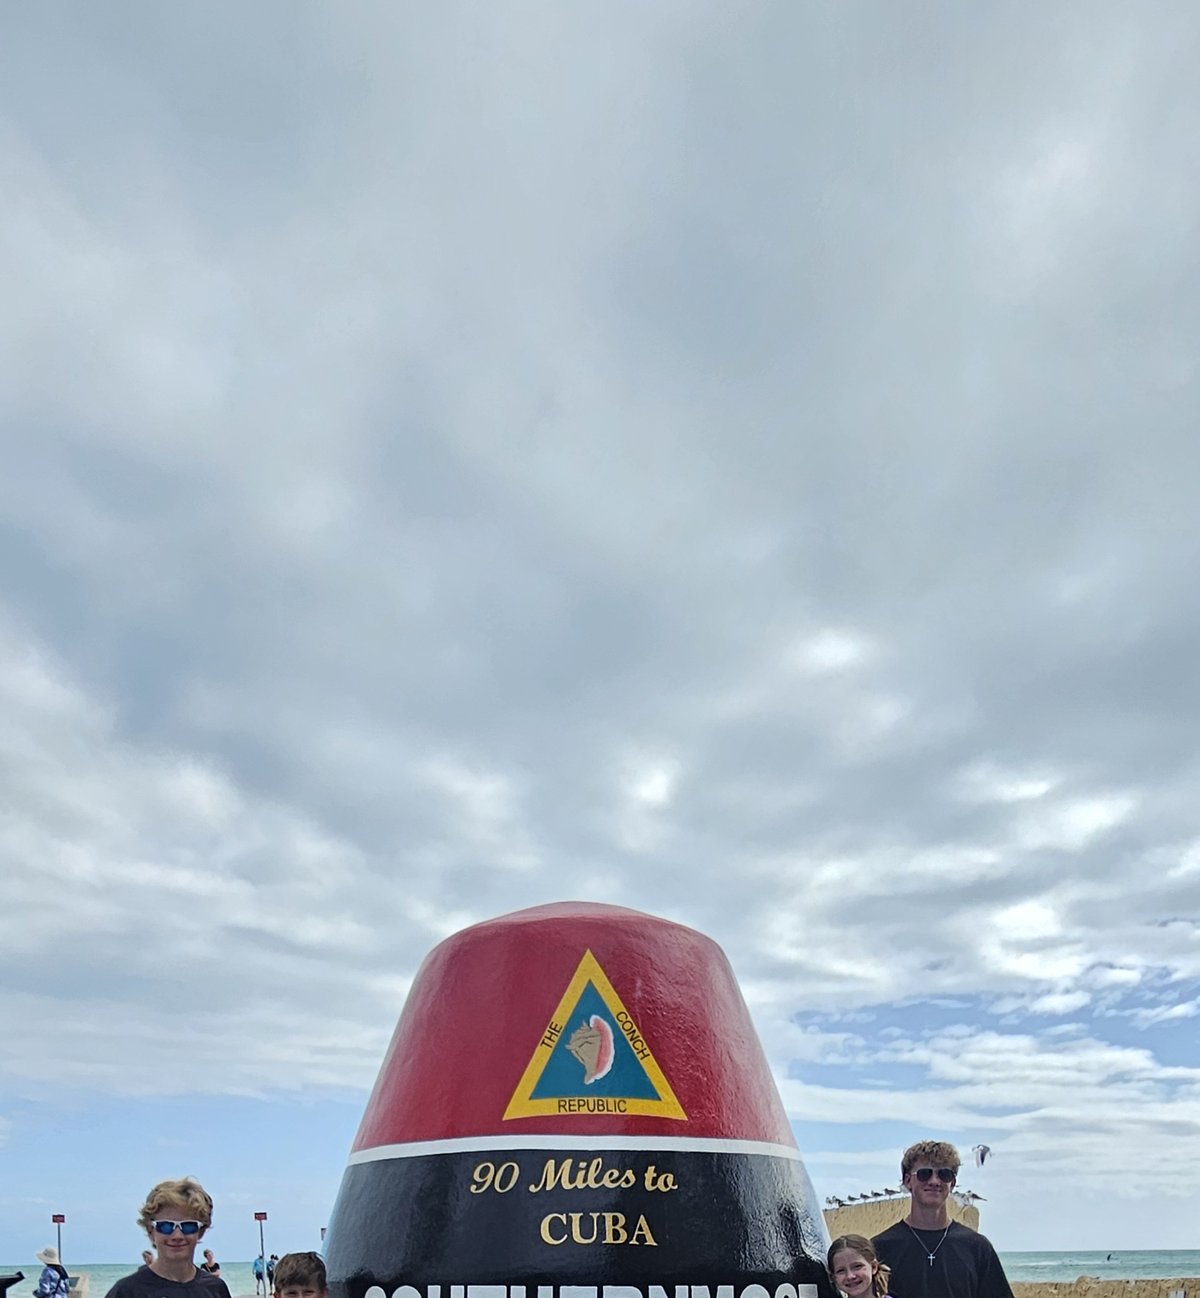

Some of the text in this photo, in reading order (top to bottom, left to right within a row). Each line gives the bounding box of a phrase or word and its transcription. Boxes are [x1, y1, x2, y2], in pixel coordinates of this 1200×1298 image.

[540, 1021, 563, 1049] THE
[616, 1011, 650, 1061] CONCH
[557, 1098, 627, 1114] REPUBLIC
[470, 1158, 678, 1193] 90 Miles to
[540, 1212, 658, 1247] CUBA
